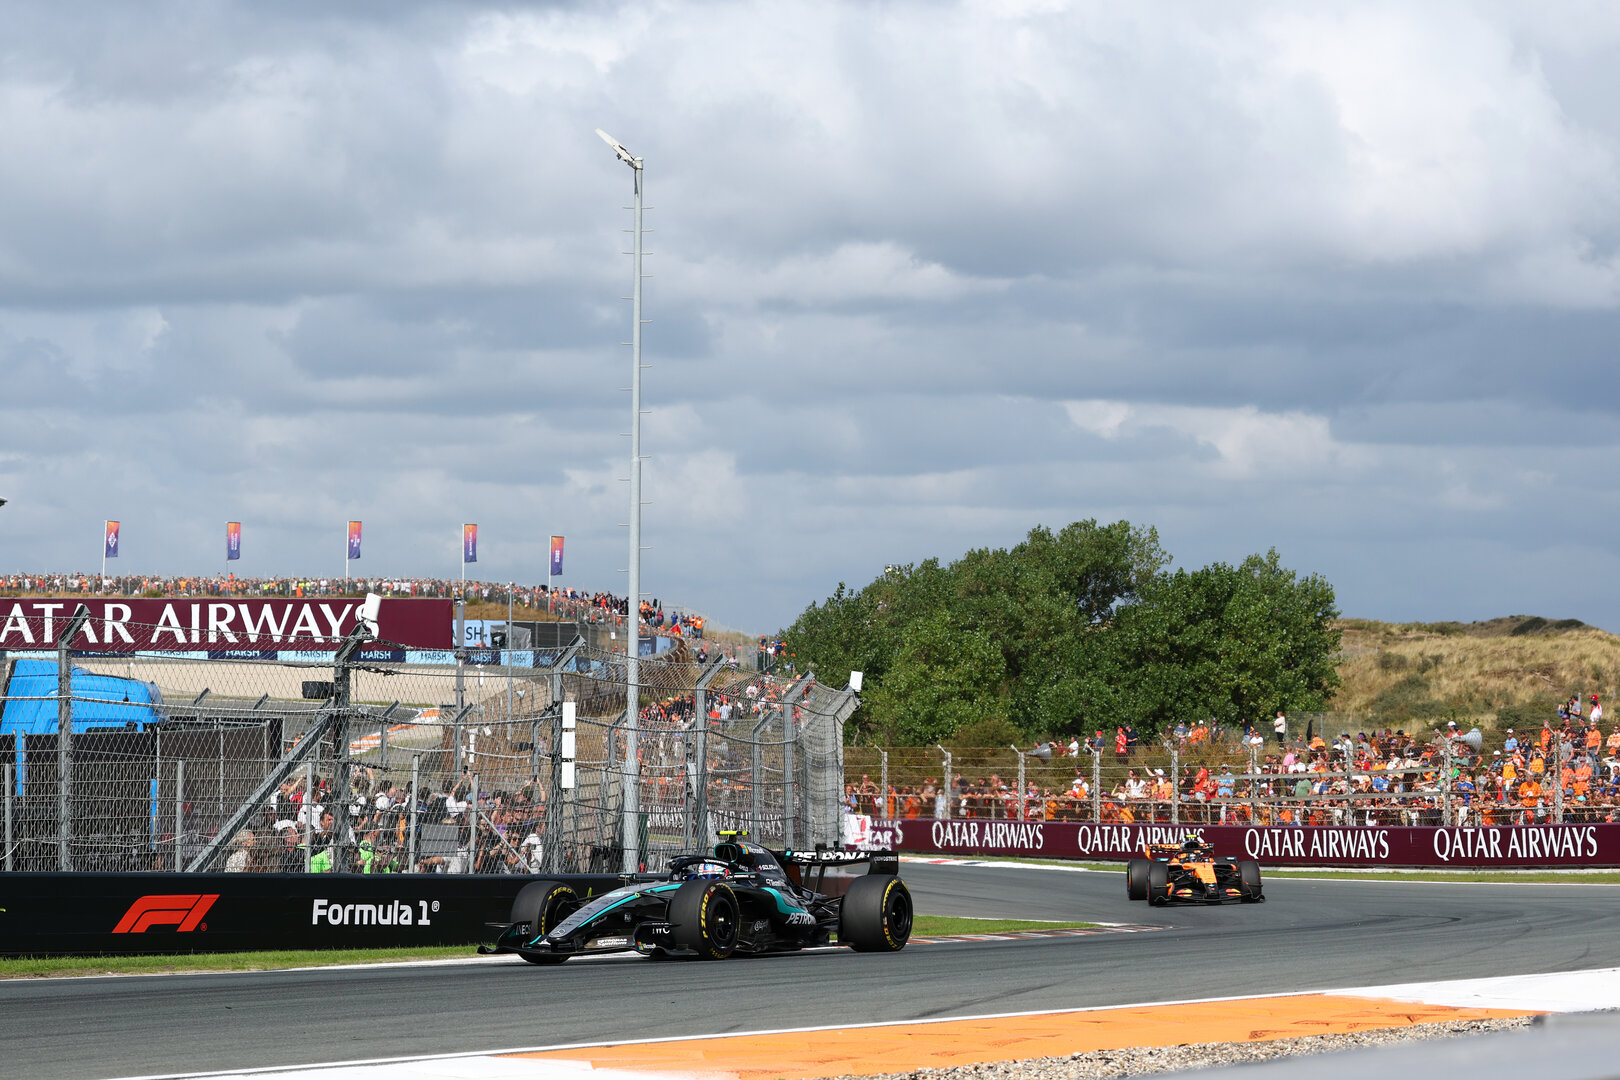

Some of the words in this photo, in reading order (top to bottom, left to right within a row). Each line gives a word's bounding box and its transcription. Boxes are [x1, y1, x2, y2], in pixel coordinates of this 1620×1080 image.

[360, 651, 391, 660] MARSH
[420, 652, 447, 661] MARSH
[932, 822, 979, 848] QATAR
[983, 823, 1044, 849] AIRWAYS
[1078, 826, 1132, 853] QATAR
[1245, 829, 1305, 860] QATAR
[1310, 830, 1389, 859] AIRWAYS
[1434, 828, 1502, 861] QATAR
[1508, 827, 1598, 857] AIRWAYS
[311, 899, 413, 925] Formula
